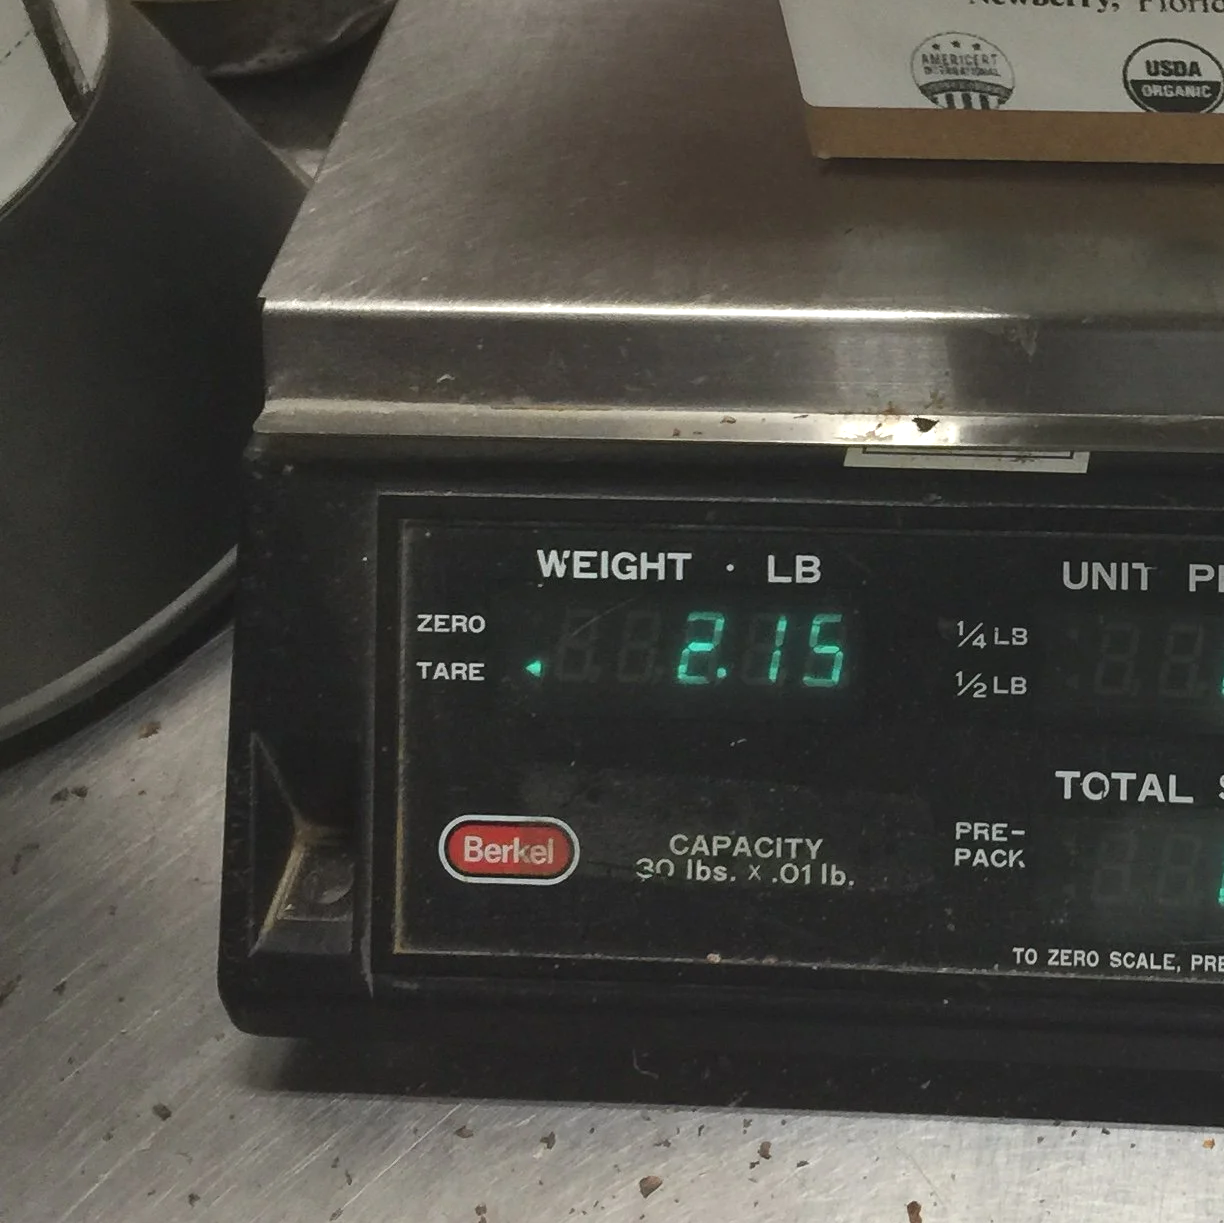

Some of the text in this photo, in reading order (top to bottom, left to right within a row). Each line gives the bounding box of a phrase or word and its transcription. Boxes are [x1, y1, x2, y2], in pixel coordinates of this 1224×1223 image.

[1145, 60, 1202, 77] USDA
[1141, 84, 1212, 98] ORGANIC
[537, 549, 822, 584] WEIGHT LB
[1062, 561, 1152, 591] UNIT
[417, 614, 486, 634] ZERO
[993, 628, 1028, 646] LB
[677, 610, 845, 688] 2.15
[417, 661, 485, 681] TARE
[992, 678, 1027, 695] LB
[1055, 770, 1194, 804] TOTAL
[955, 821, 1026, 842] PRE-
[463, 836, 554, 865] Berkel
[669, 833, 824, 859] CAPACITY
[954, 848, 1025, 868] PACK
[687, 858, 737, 882] lbs.
[747, 863, 763, 882] x
[1013, 947, 1038, 965] TO
[1048, 948, 1100, 967] ZERO
[1109, 951, 1181, 973] SCALE,
